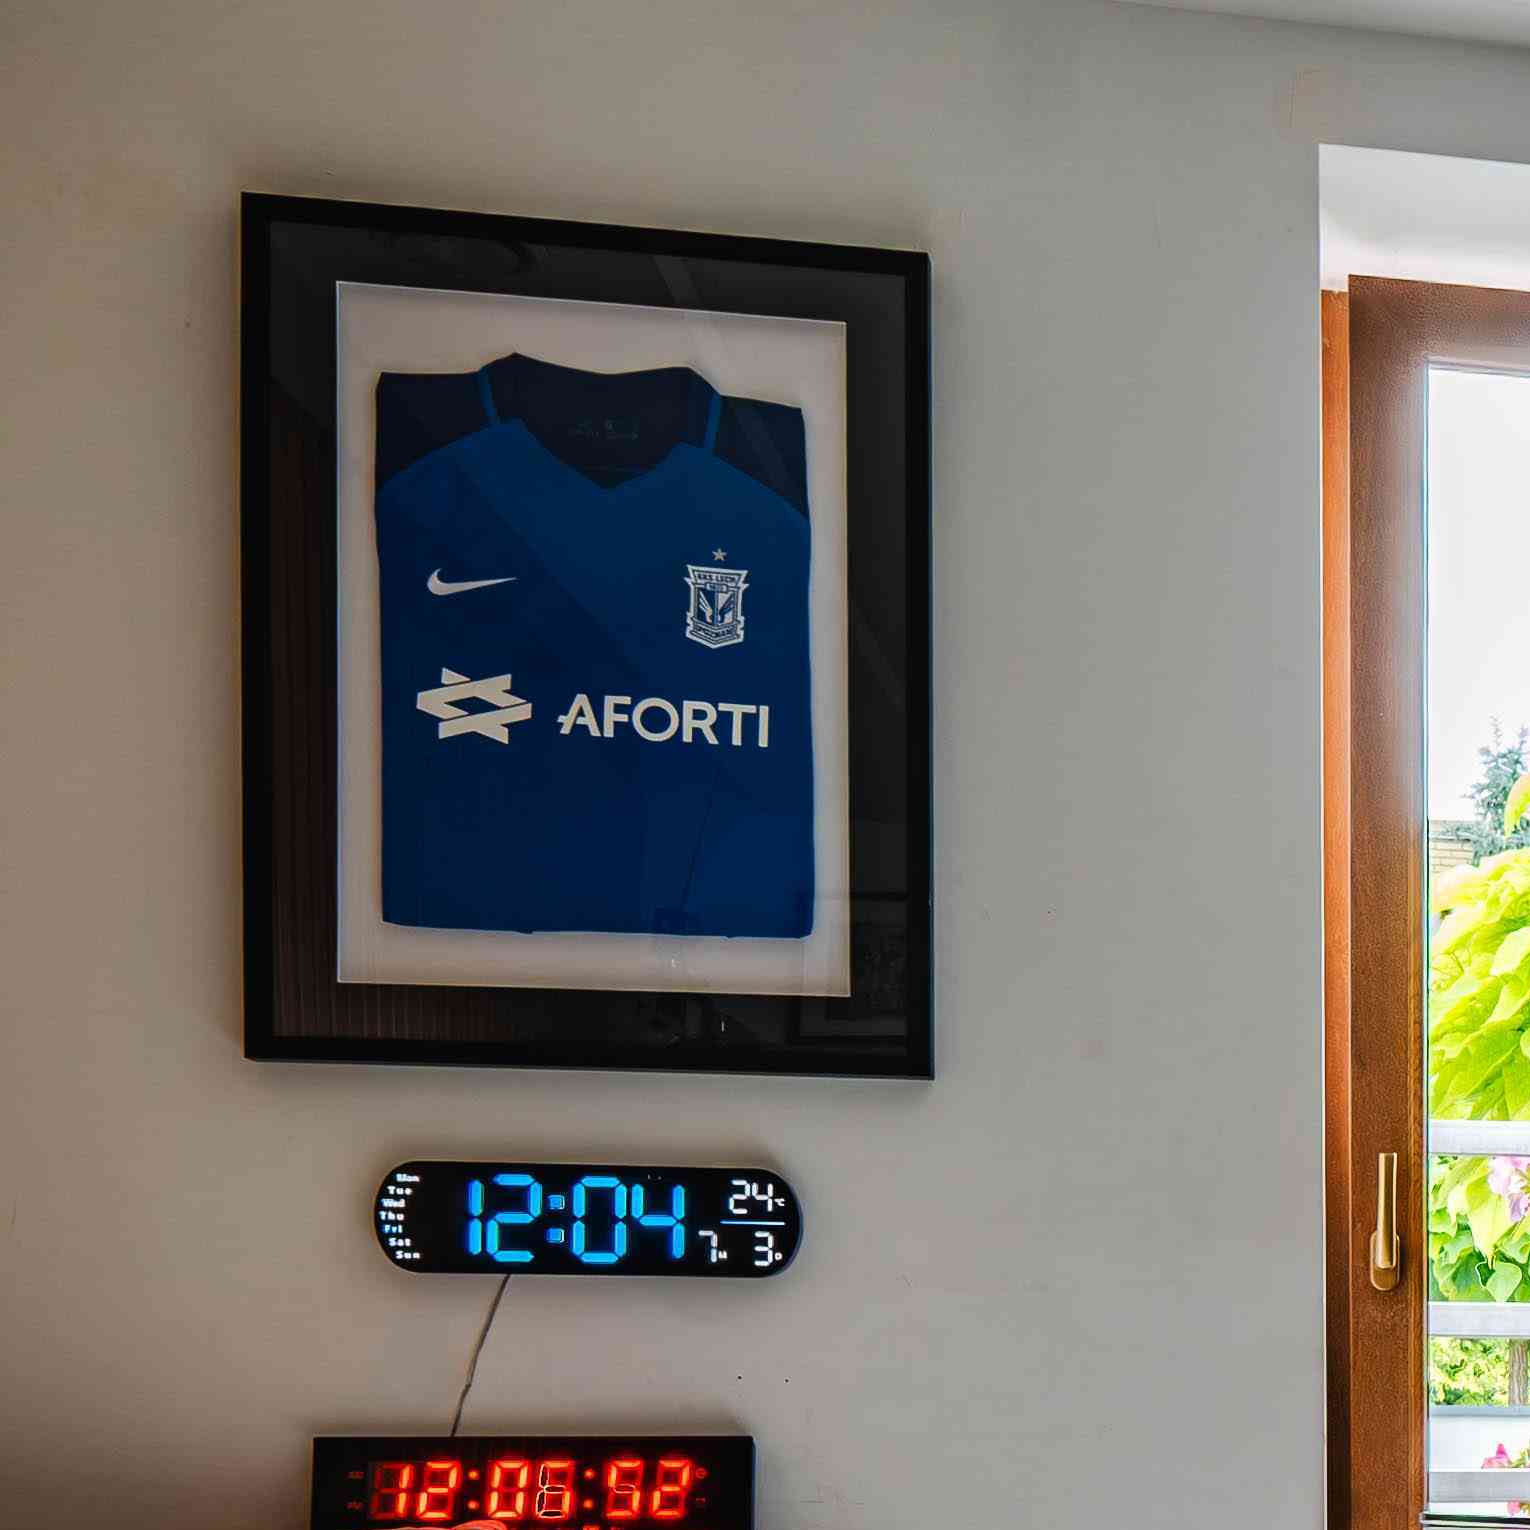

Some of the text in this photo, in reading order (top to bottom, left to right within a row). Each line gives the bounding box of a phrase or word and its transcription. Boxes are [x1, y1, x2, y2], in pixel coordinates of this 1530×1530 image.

[557, 693, 769, 748] AFORTI
[387, 1185, 412, 1195] Tue
[379, 1211, 404, 1221] Thu
[467, 1173, 688, 1264] 12:04
[383, 1224, 403, 1234] Fri
